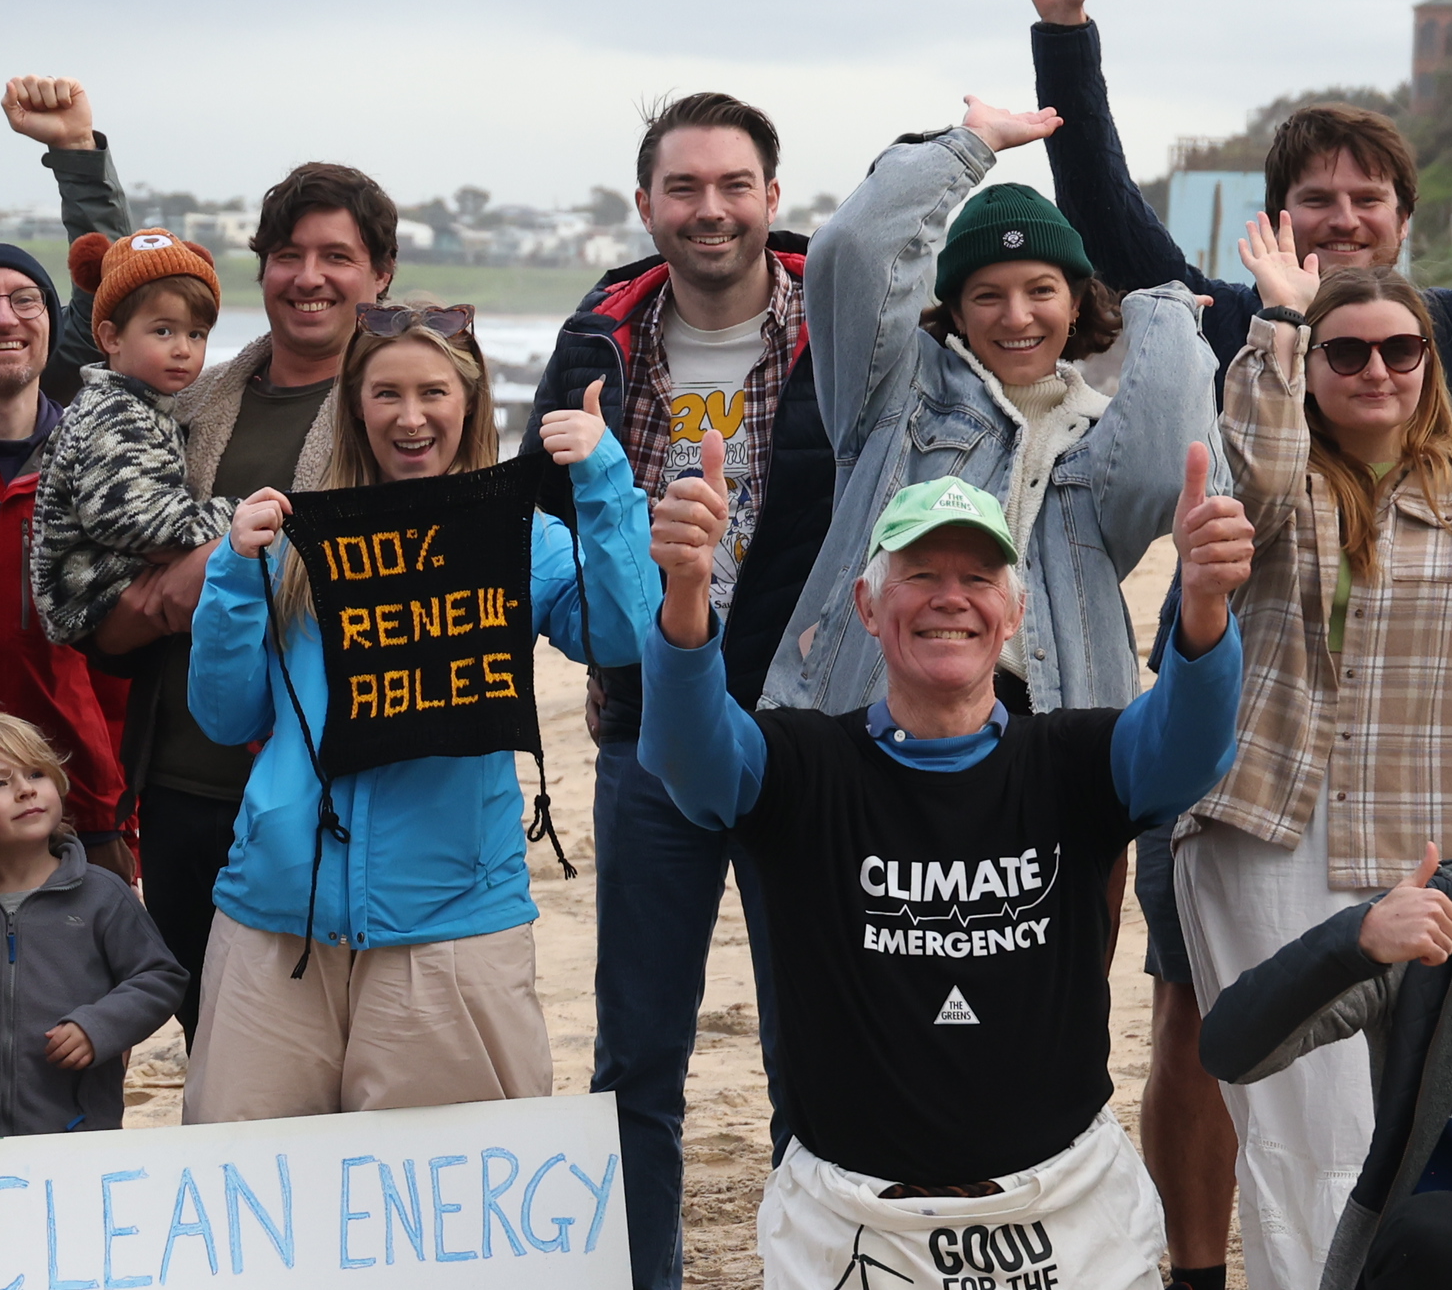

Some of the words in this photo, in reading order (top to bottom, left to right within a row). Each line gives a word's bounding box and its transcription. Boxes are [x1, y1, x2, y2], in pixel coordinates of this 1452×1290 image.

[723, 440, 749, 466] ill
[939, 499, 972, 511] GREENS
[947, 492, 963, 501] THE
[319, 524, 444, 581] 100%
[349, 652, 518, 719] ABLES
[859, 847, 1043, 902] CLIMATE
[863, 917, 1051, 958] EMERGENCY
[941, 1011, 971, 1020] GREENS
[949, 1001, 963, 1010] THE
[340, 1146, 618, 1270] ENERGY
[929, 1220, 1054, 1276] GOOD
